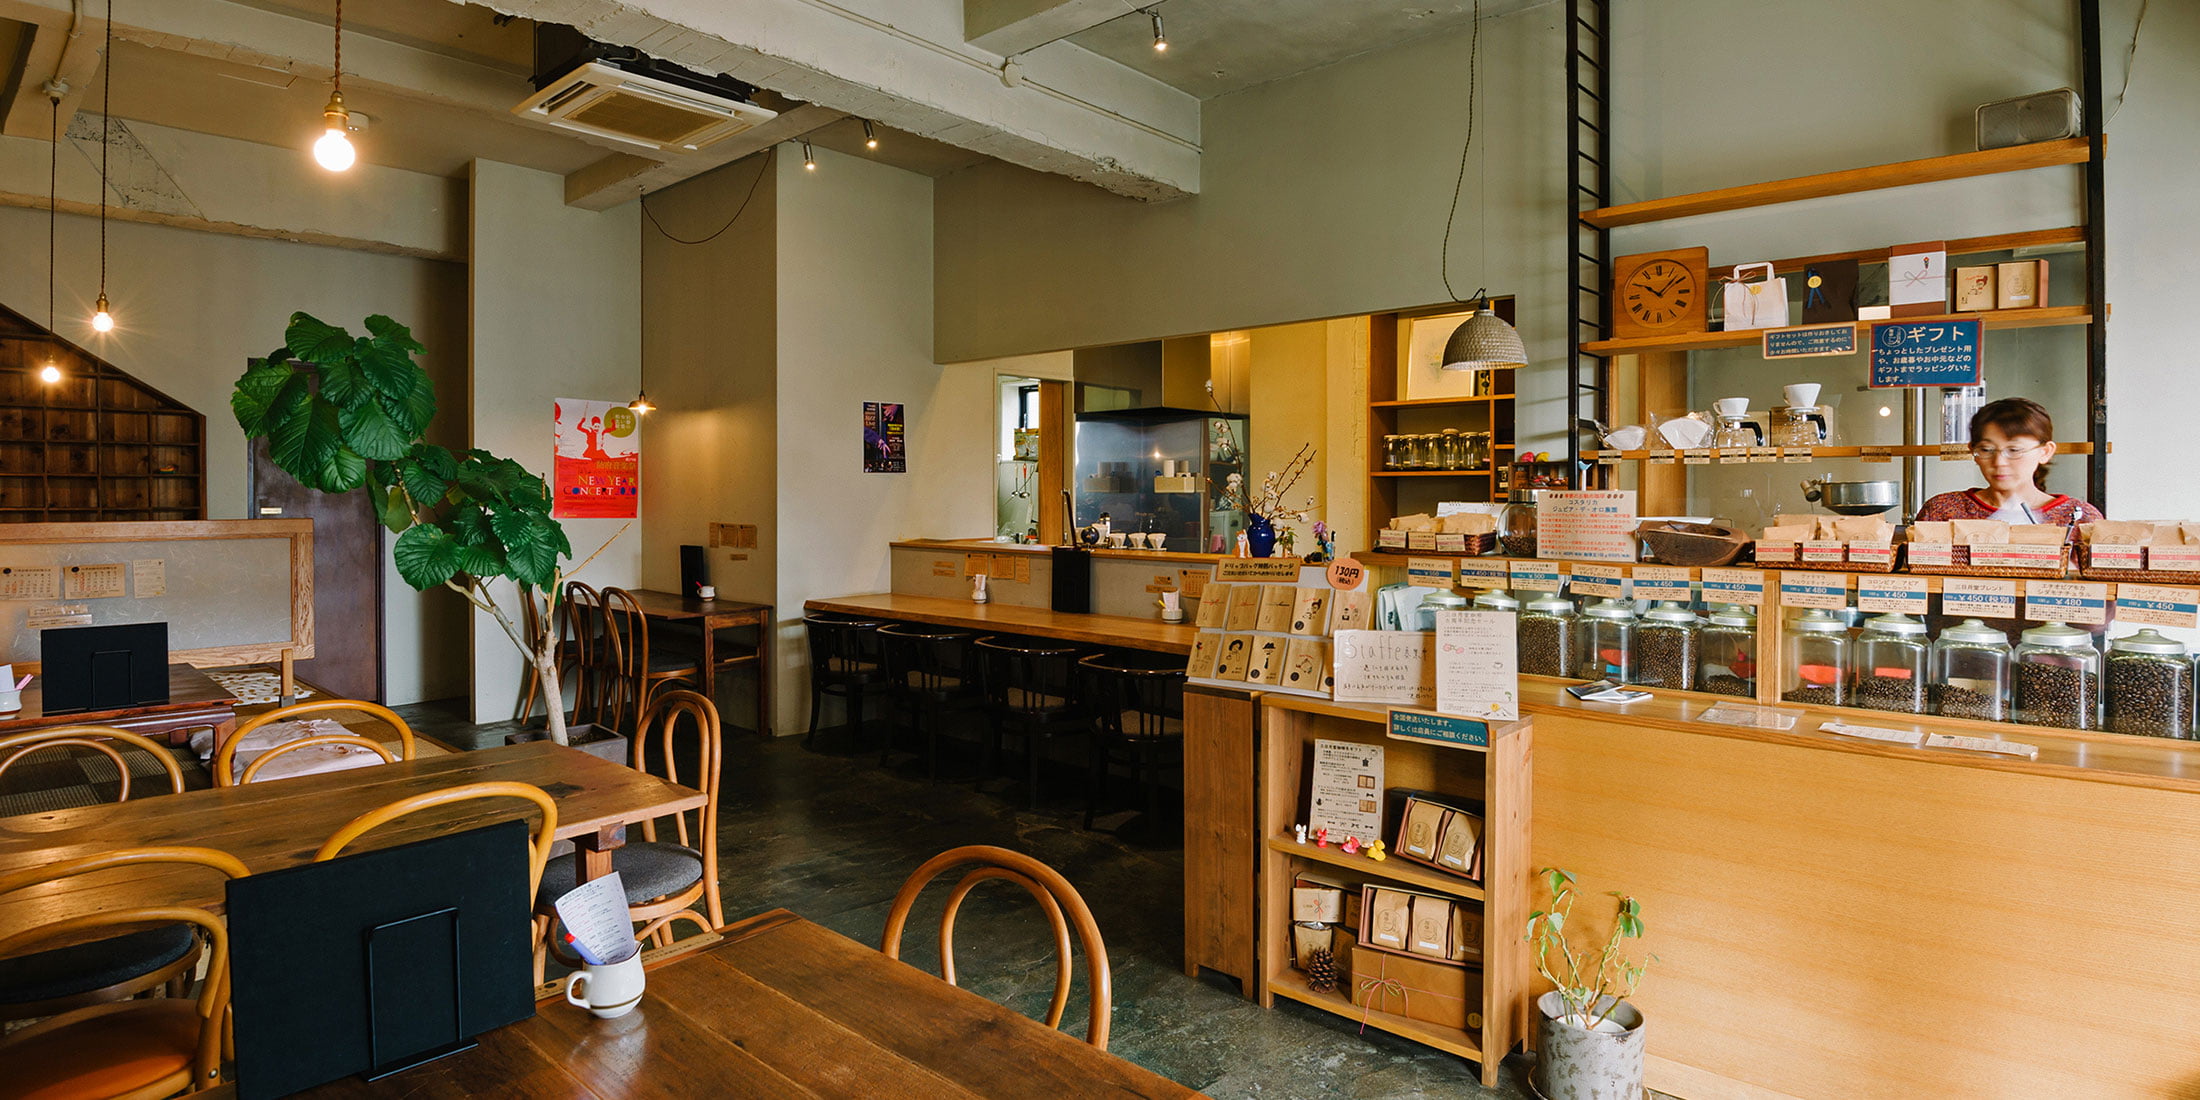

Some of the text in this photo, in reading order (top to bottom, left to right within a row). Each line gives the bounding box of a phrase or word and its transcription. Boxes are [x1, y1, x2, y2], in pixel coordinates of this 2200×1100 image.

[1907, 325, 1964, 343] ギフト
[1878, 345, 1972, 355] ちょっとしたプレゼント用
[1878, 355, 1971, 364] や、お歳暮やお中元などの
[1878, 364, 1971, 373] ギフトまでラッピングいた
[578, 475, 636, 486] NEW YEAR
[563, 486, 637, 496] CONCERT 2020
[1335, 565, 1360, 578] 130円
[1393, 713, 1452, 728] 全国発送いたします。
[1393, 724, 1485, 743] 詳しくは店員にご相談ください。
